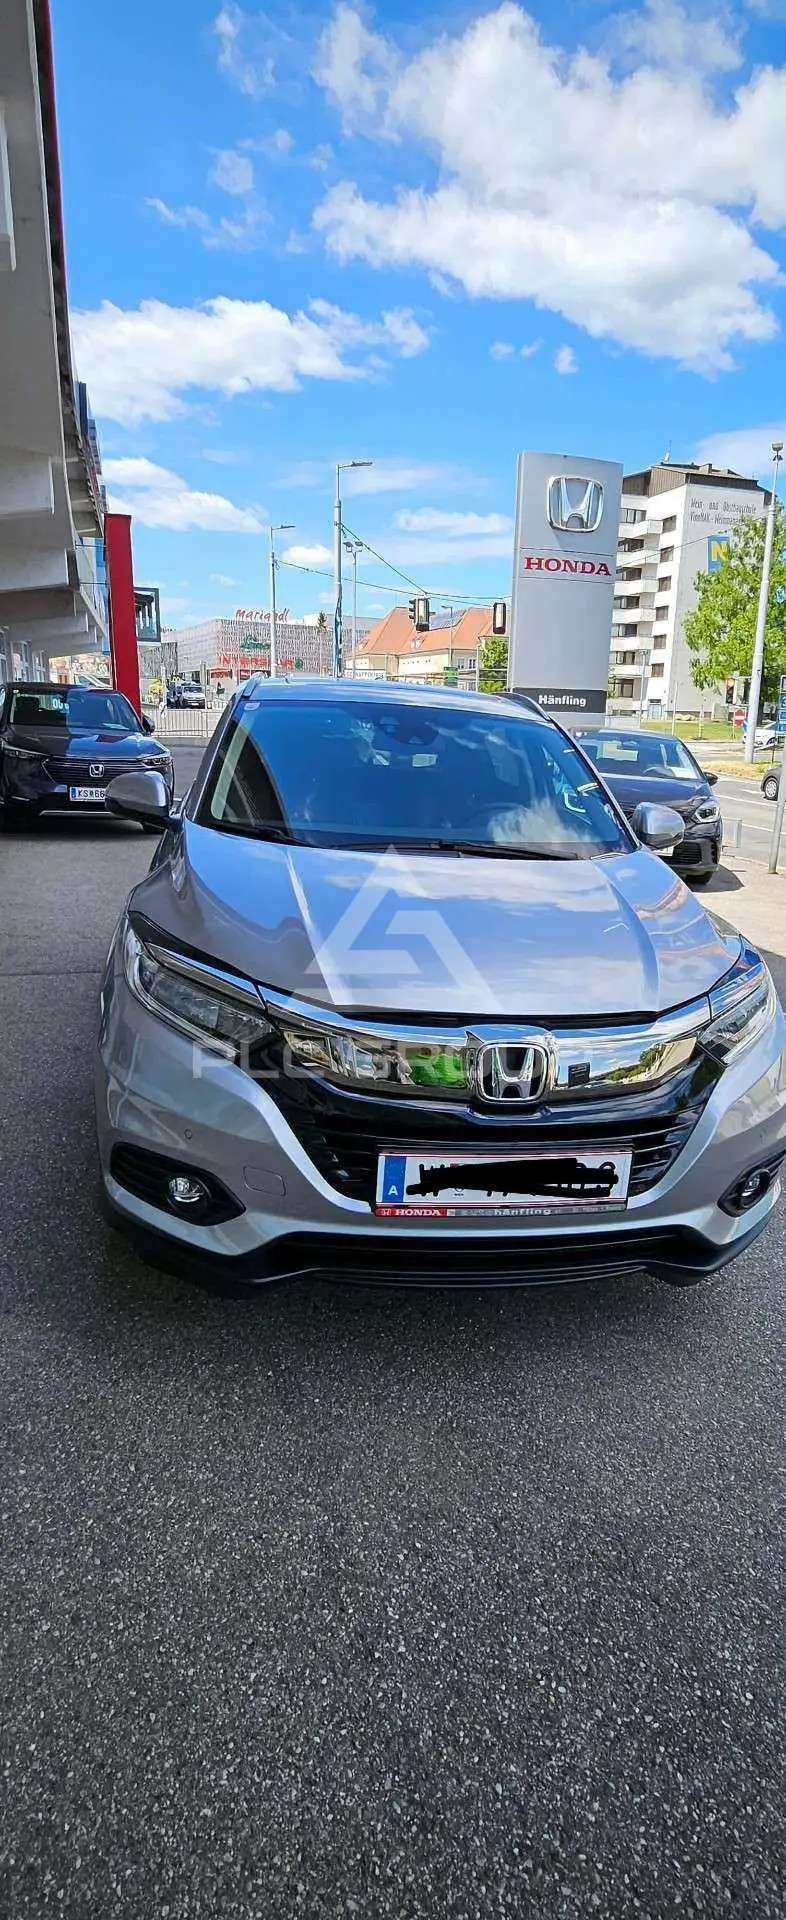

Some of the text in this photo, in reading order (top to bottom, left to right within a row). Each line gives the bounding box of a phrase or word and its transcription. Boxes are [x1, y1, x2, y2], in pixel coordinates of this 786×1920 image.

[524, 556, 611, 577] HONDA
[538, 694, 587, 707] Hänfling
[388, 1185, 398, 1196] A
[394, 1208, 441, 1217] HONDA
